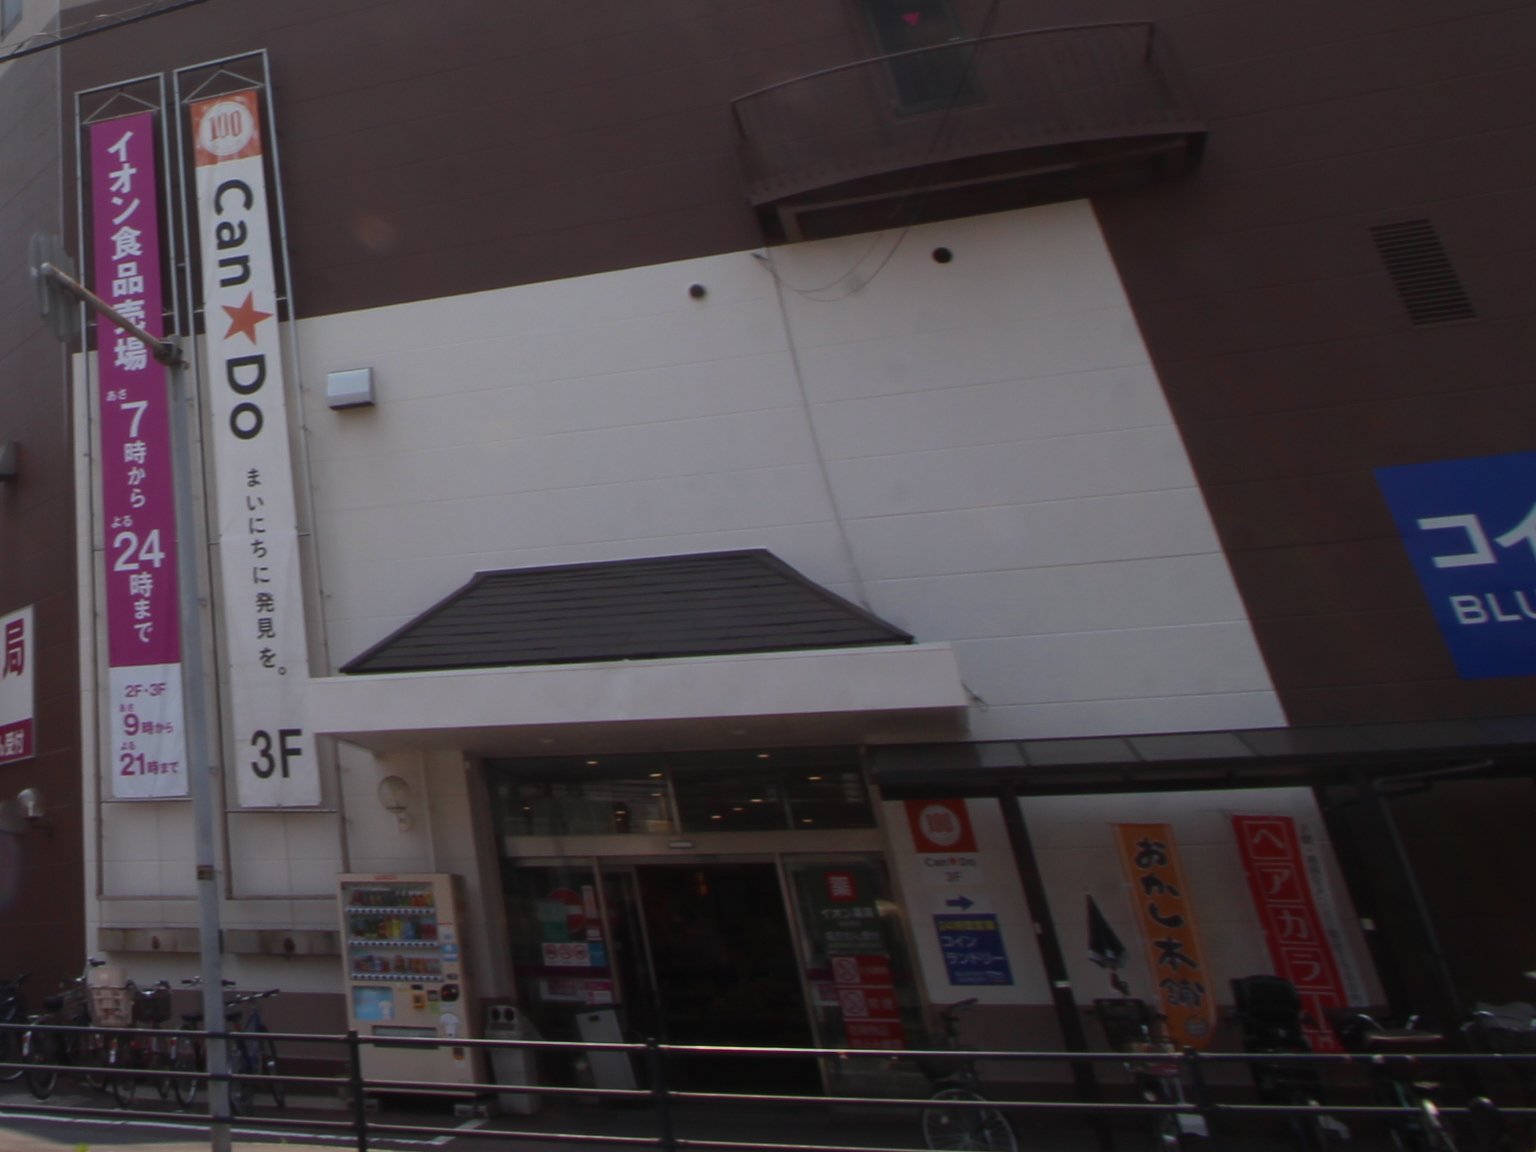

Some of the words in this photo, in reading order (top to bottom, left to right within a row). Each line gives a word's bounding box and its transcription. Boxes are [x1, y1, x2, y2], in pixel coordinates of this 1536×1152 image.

[106, 130, 149, 372] イオン食品売場
[246, 467, 287, 676] まいにちに発見を。
[119, 752, 180, 777] 21時まで
[250, 728, 303, 779] 3F
